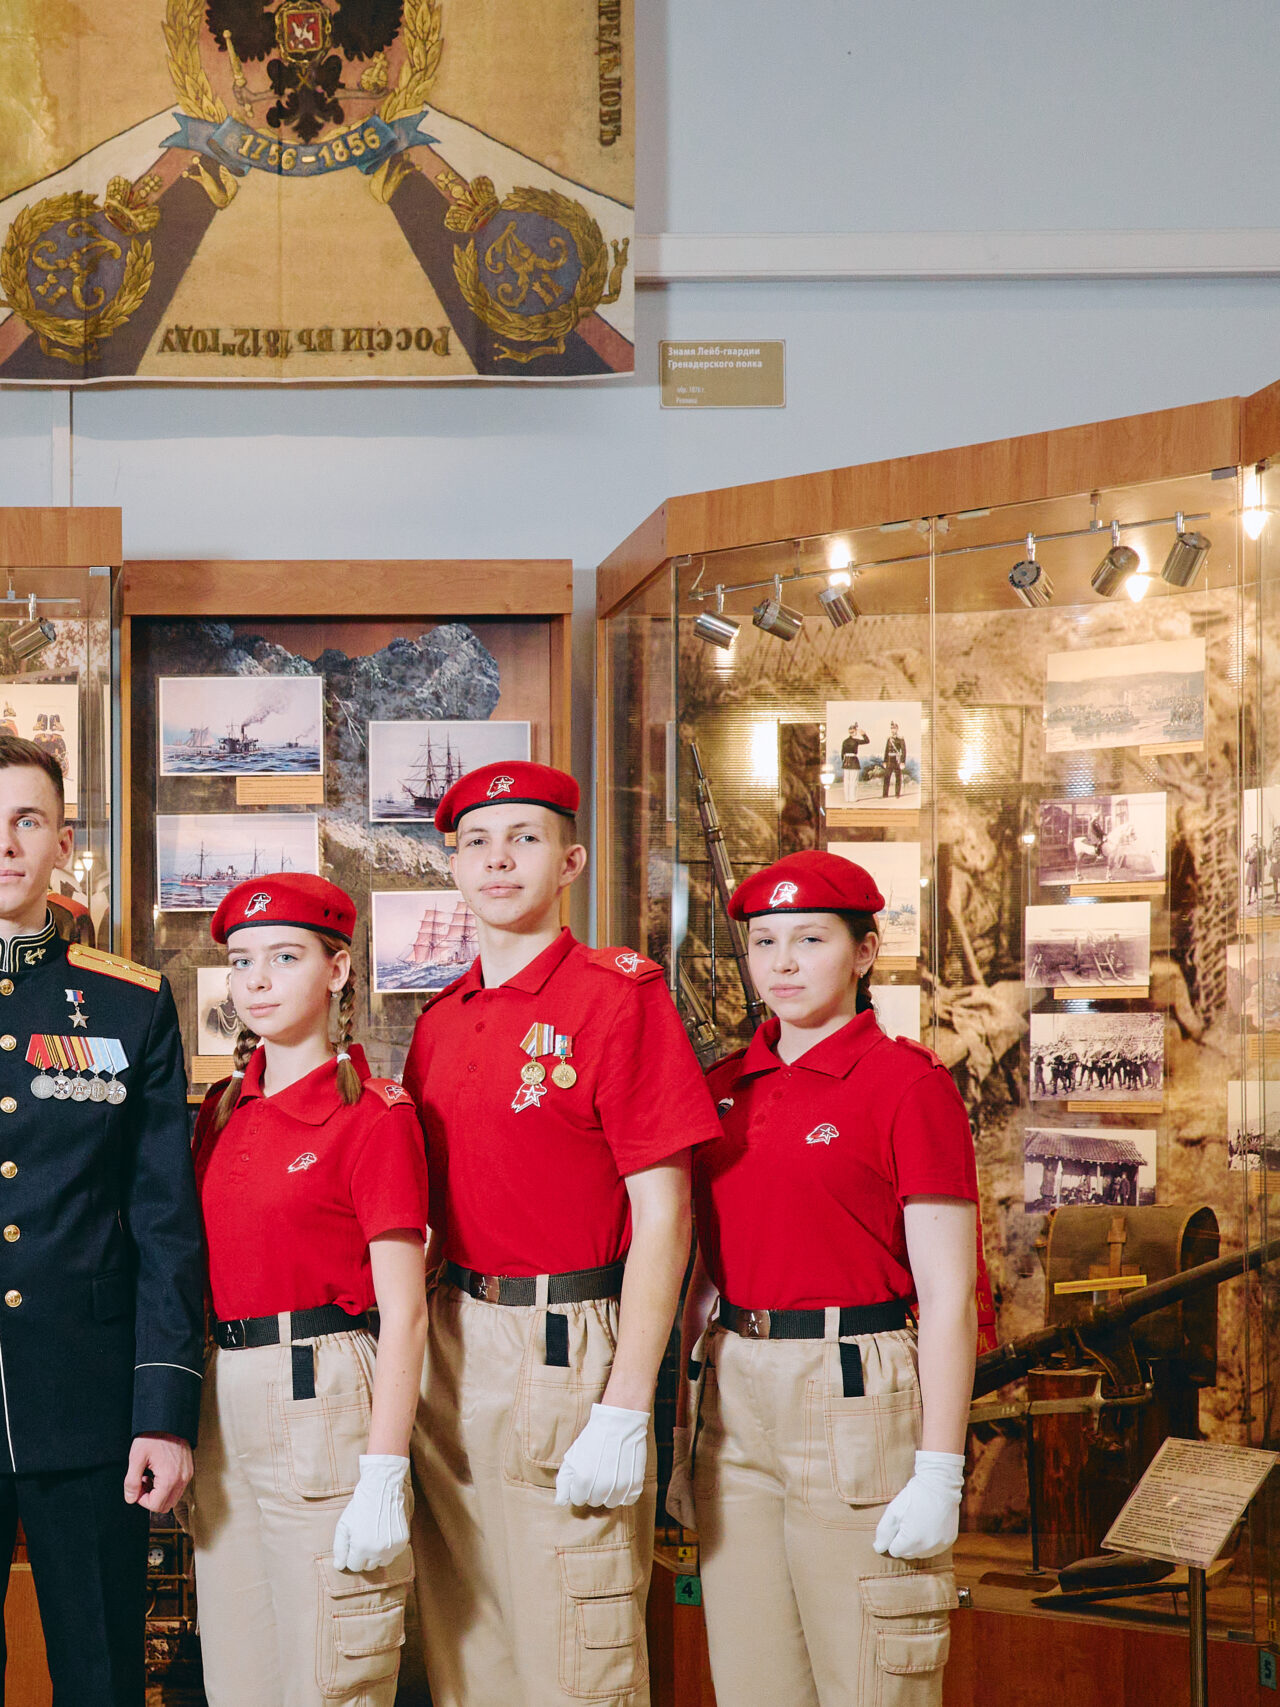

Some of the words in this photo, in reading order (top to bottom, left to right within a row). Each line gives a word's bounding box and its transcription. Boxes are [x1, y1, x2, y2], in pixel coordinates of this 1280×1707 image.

[667, 346, 696, 356] Знамя
[697, 346, 761, 357] Лейб-гвардии
[667, 360, 734, 370] Гренадерского
[735, 360, 763, 368] полка
[682, 1548, 688, 1556] 4
[681, 1581, 694, 1598] 4
